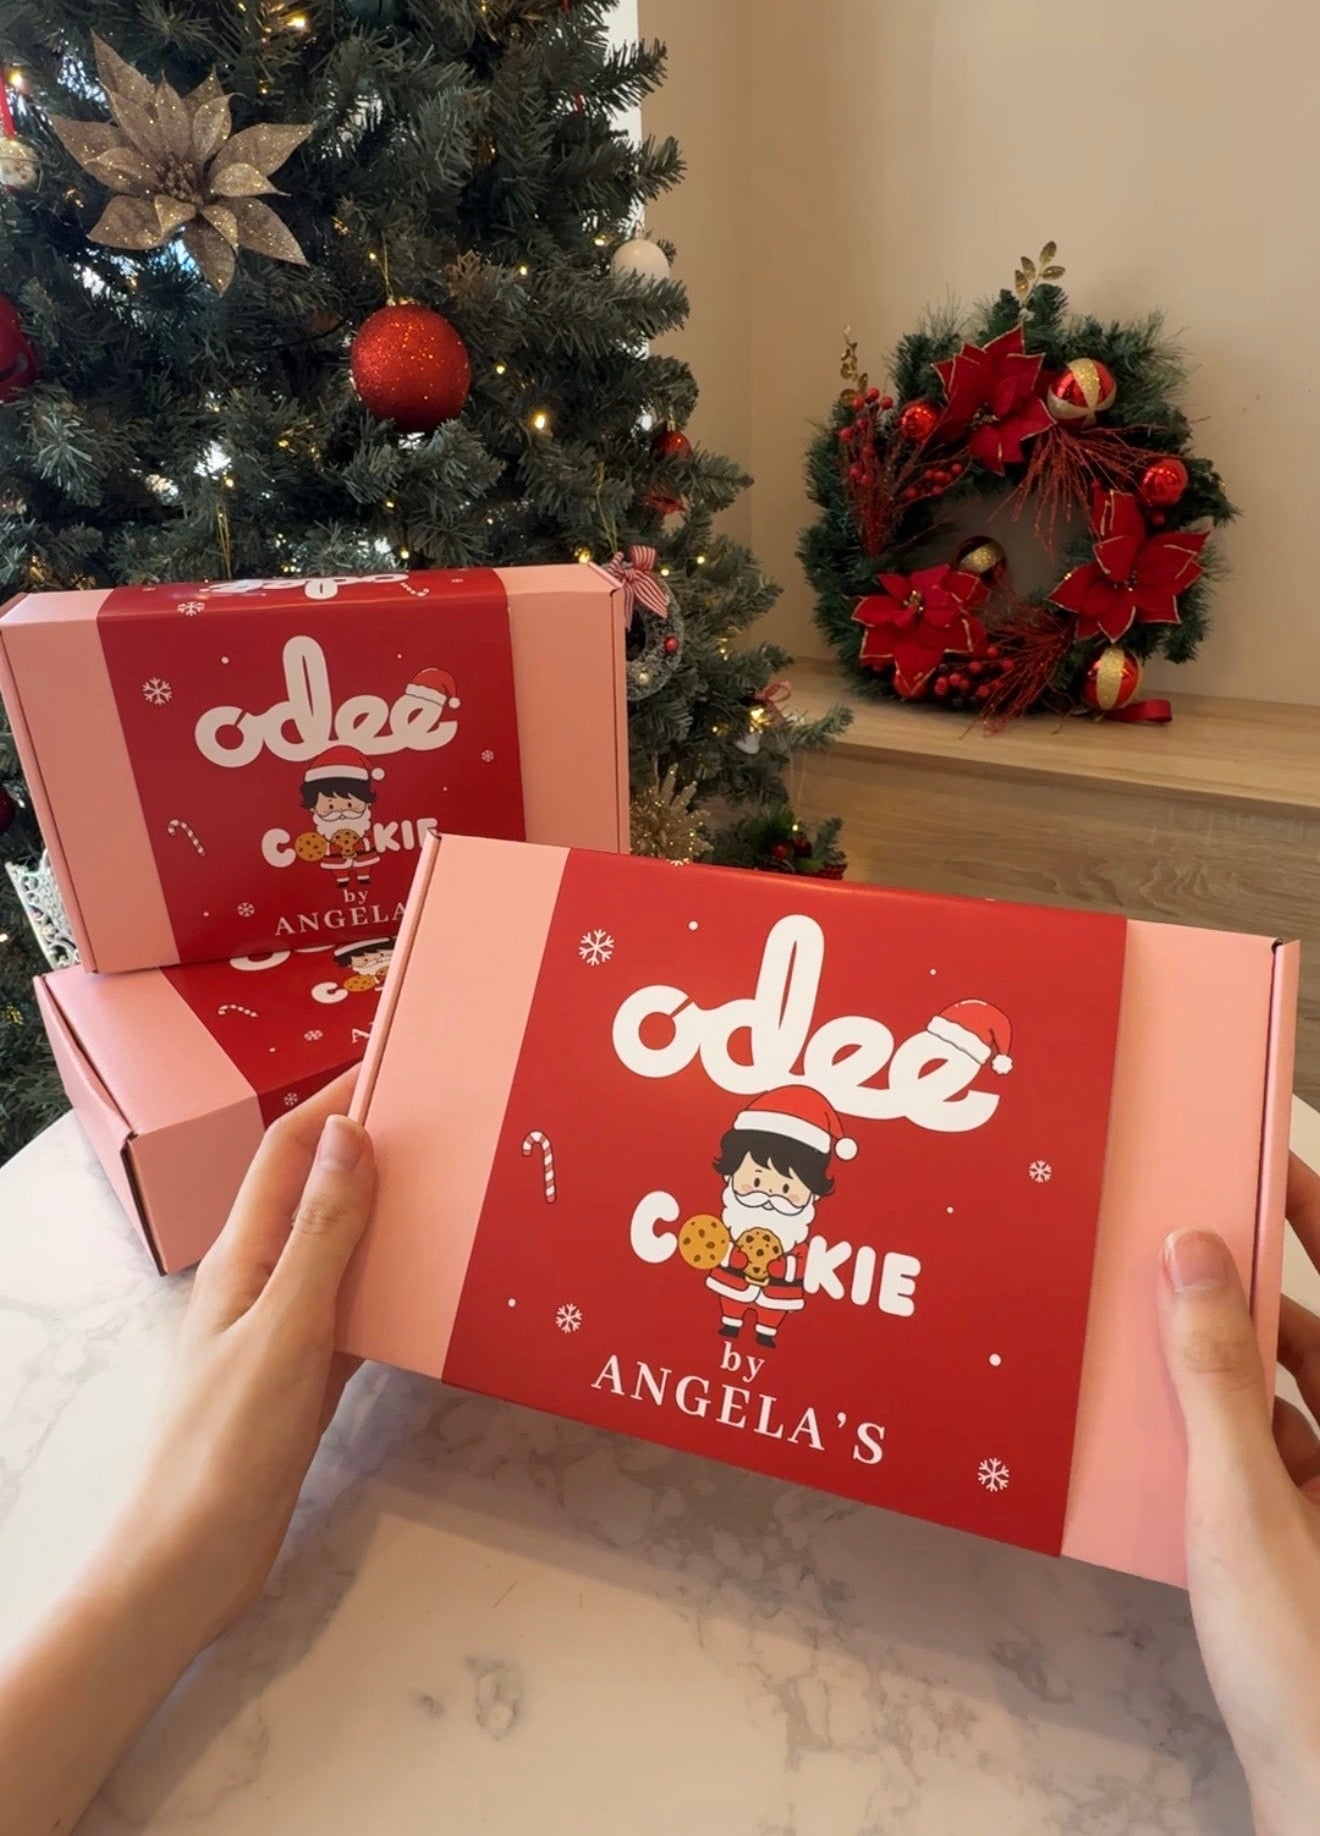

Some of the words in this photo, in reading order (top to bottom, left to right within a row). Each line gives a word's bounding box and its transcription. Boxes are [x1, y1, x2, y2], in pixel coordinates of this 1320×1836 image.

[195, 636, 458, 768] odee
[274, 902, 408, 936] ANGELA
[342, 888, 368, 904] by
[612, 914, 1000, 1132] odee
[720, 1341, 765, 1381] by
[591, 1354, 886, 1465] ANGELA'S
